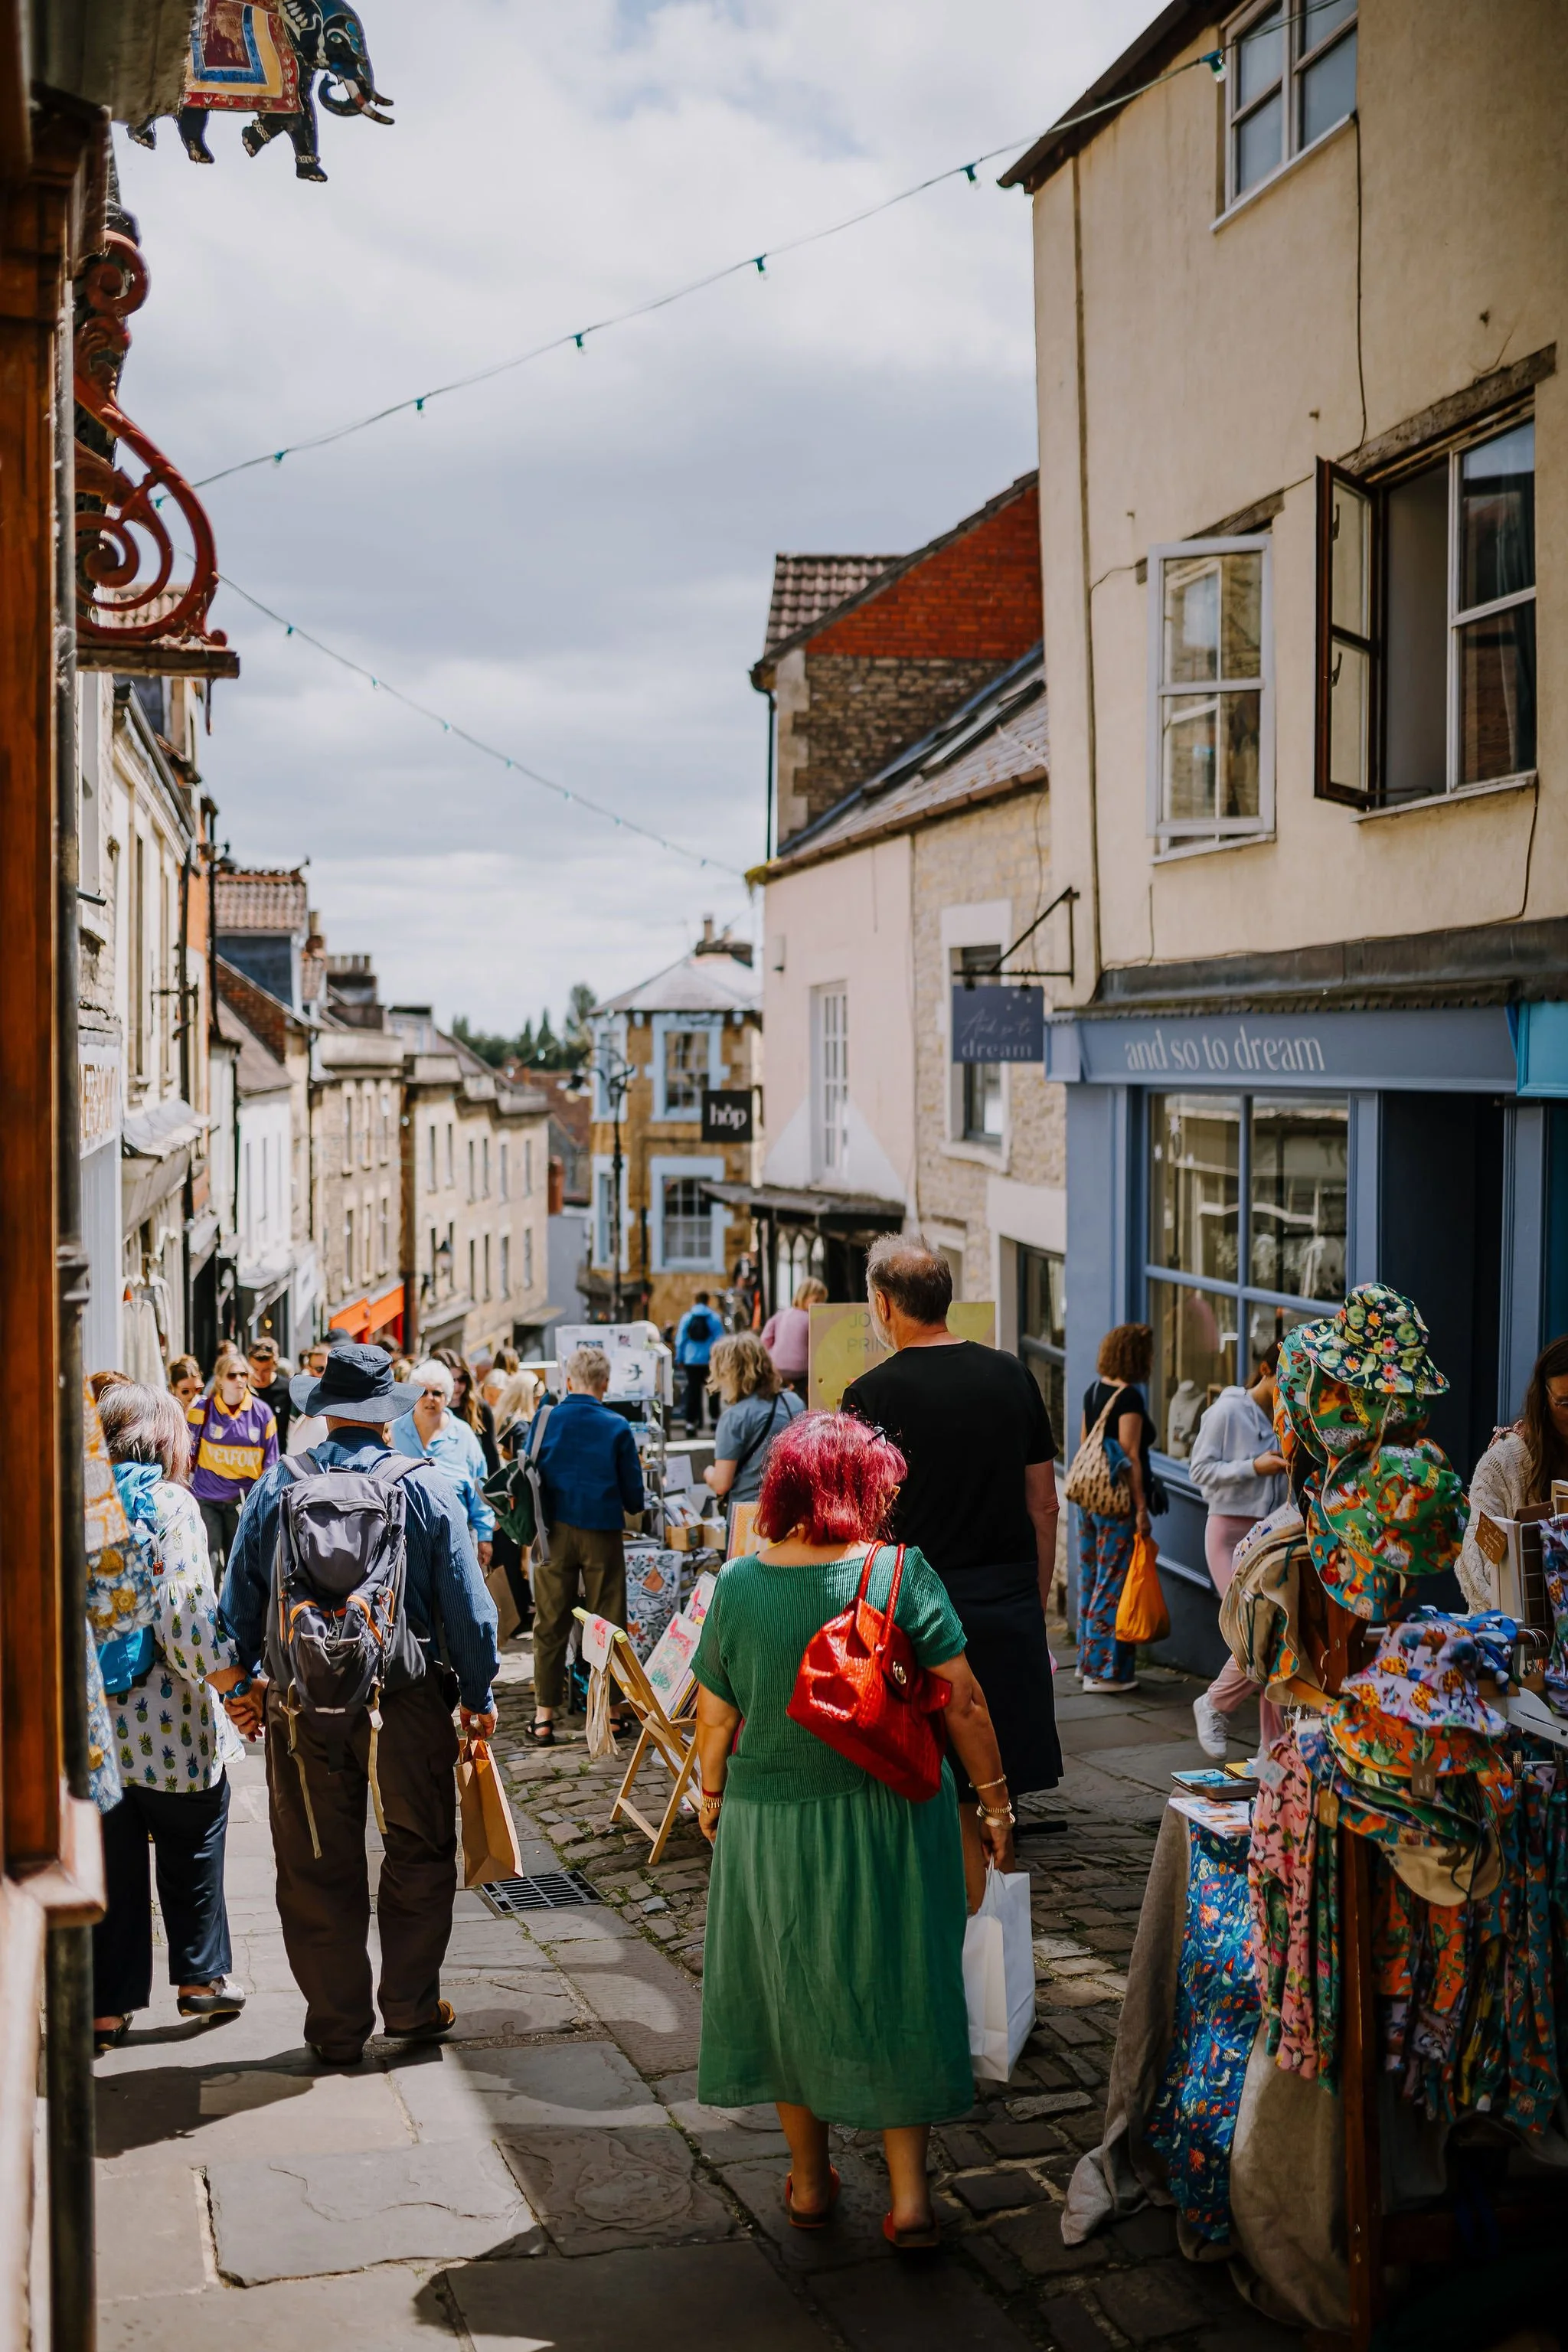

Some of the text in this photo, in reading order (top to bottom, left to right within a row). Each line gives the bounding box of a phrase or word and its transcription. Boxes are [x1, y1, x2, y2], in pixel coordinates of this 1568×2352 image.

[962, 1039, 1032, 1057] dream
[1125, 1024, 1325, 1071] and so to dream
[847, 1337, 887, 1353] PRIN
